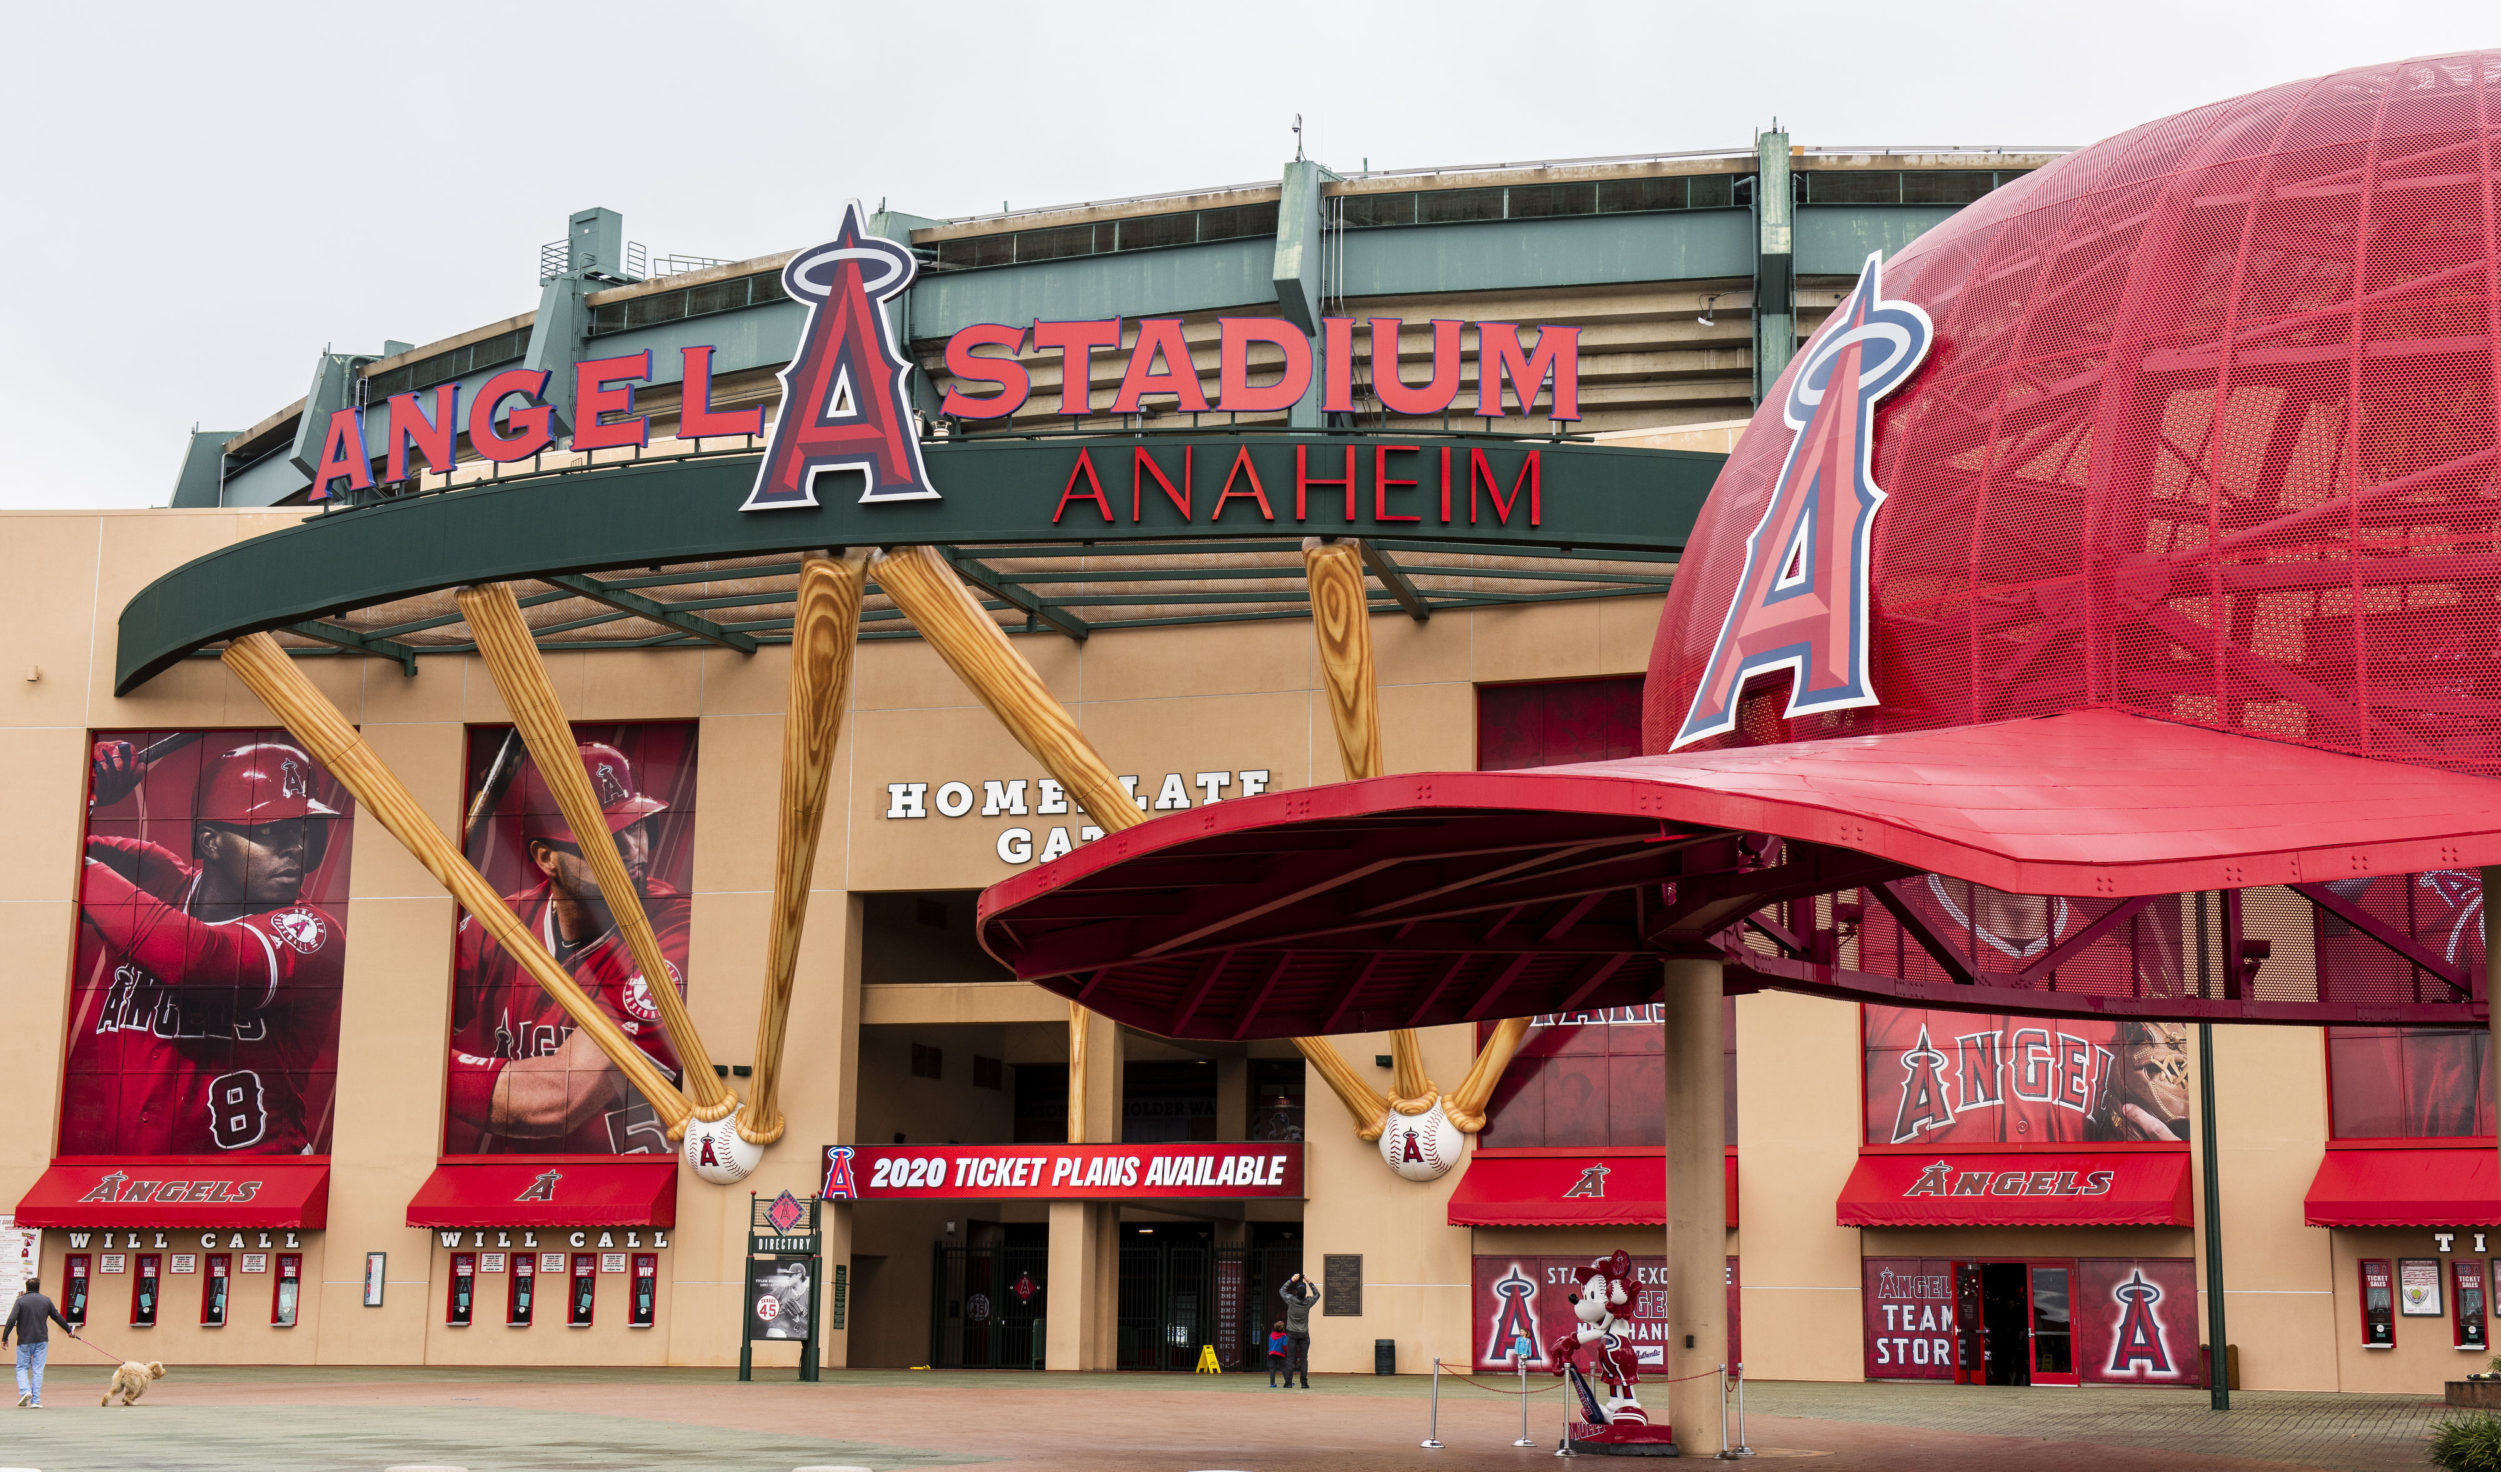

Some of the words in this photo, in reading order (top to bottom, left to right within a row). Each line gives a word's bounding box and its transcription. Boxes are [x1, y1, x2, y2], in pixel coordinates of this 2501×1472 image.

[308, 344, 766, 502] ANGEL
[738, 197, 943, 511] A
[939, 315, 1583, 422] STADIUM
[1052, 443, 1541, 526] ANAHEIM
[1669, 249, 1934, 751] A
[886, 778, 1069, 819] HOME
[1077, 769, 1271, 813] LATE
[1890, 1022, 2115, 1144] ANGEL
[207, 1070, 267, 1150] 8
[700, 1131, 720, 1167] A
[1402, 1126, 1424, 1163] A
[77, 1170, 263, 1203] ANGELS
[516, 1168, 563, 1202] A
[823, 1146, 858, 1199] A
[869, 1157, 947, 1188] 2020
[954, 1156, 1048, 1188] TICKET
[1050, 1156, 1141, 1187] PLANS
[1143, 1154, 1288, 1187] AVAILABLE
[1562, 1162, 1612, 1198] A
[1902, 1160, 2115, 1197] ANGELS
[69, 1232, 168, 1249] WILL
[200, 1232, 300, 1249] CALL
[440, 1231, 538, 1248] WILL
[569, 1231, 668, 1248] CALL
[758, 1238, 811, 1251] DIRECTORY
[638, 1267, 653, 1277] VIP
[1878, 1266, 1953, 1299] ANGEL
[759, 1303, 777, 1317] 45
[1490, 1266, 1542, 1360] A
[1882, 1304, 1954, 1332] TEAM
[2109, 1268, 2175, 1373] A
[1876, 1338, 1967, 1365] STORE
